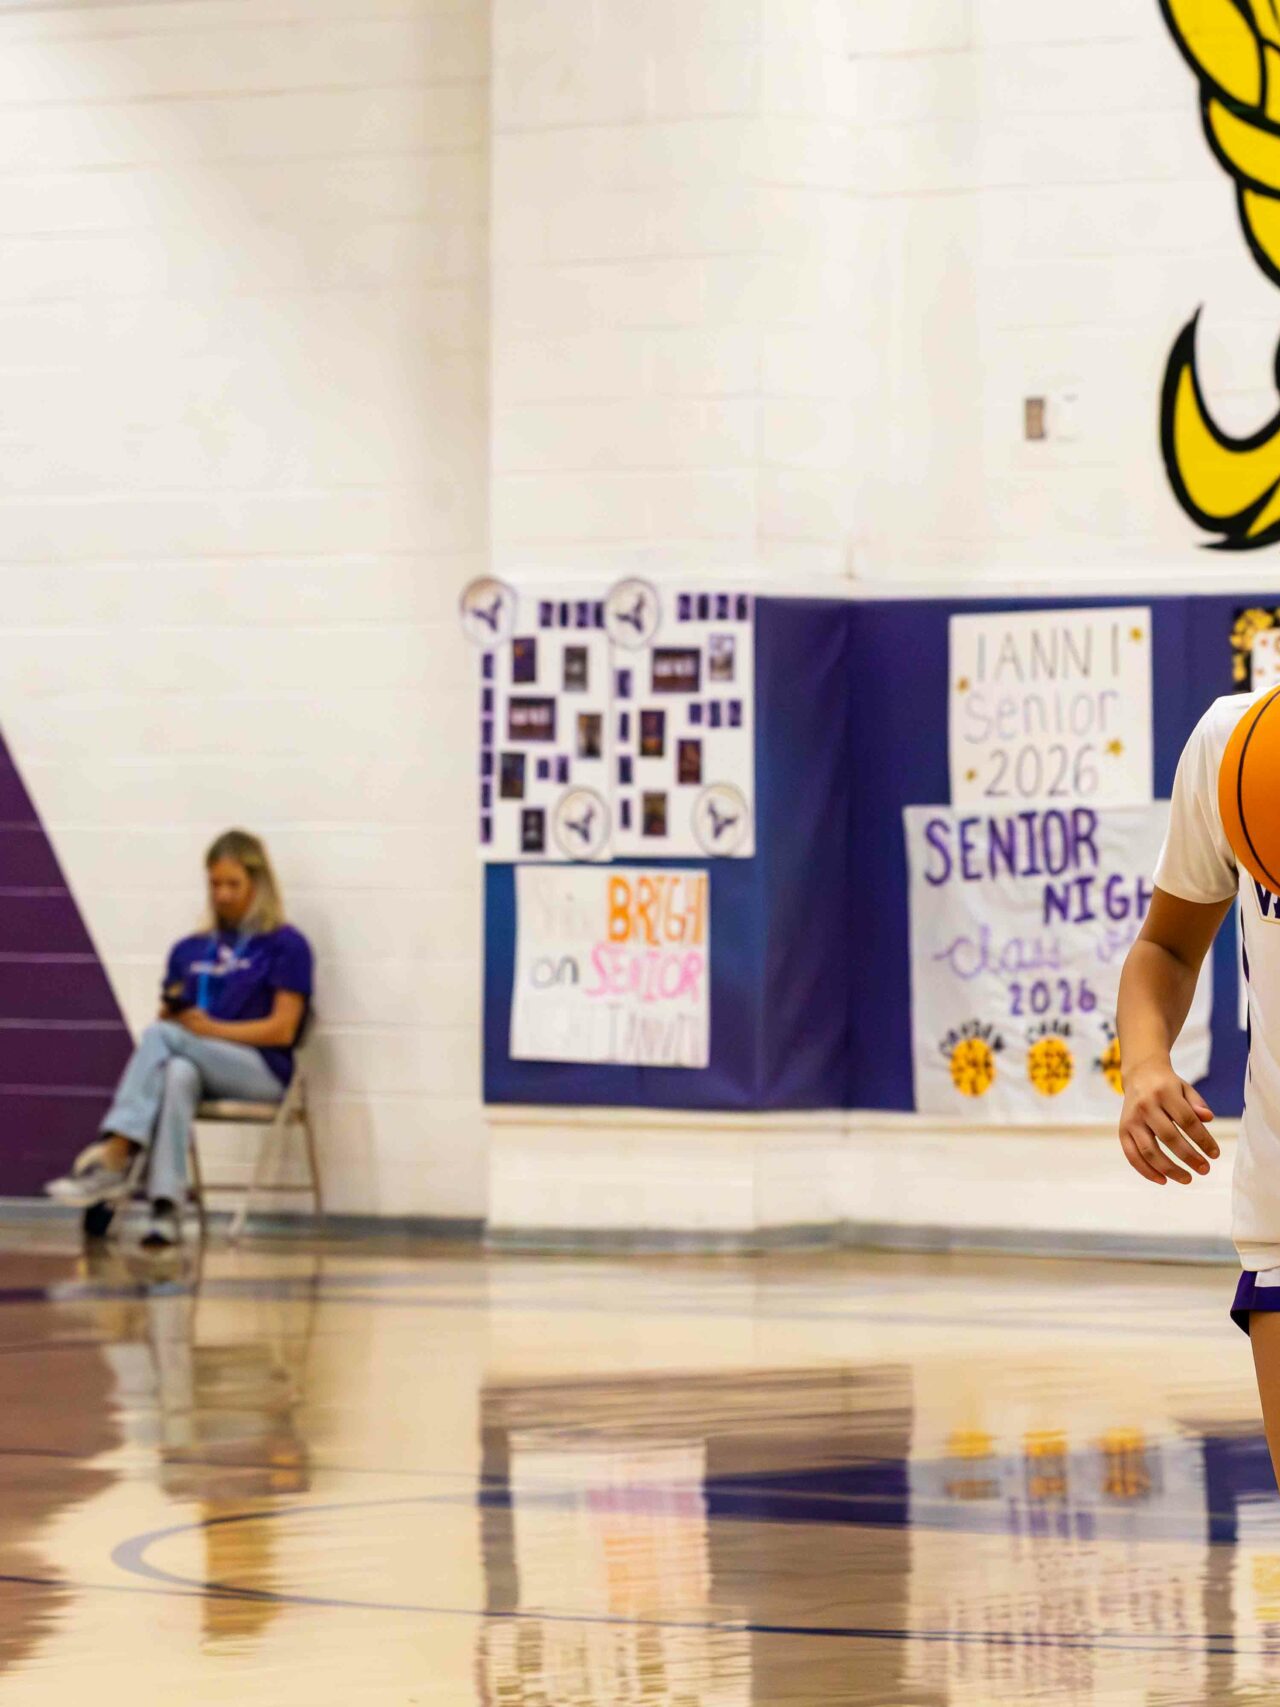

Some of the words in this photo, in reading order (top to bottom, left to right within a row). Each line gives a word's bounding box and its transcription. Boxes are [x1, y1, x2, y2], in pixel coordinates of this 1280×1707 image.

[983, 744, 1099, 798] 2026
[924, 808, 1099, 887] SENIOR
[1043, 876, 1153, 925] NIGH
[530, 956, 580, 989] on
[1007, 980, 1098, 1016] 2026
